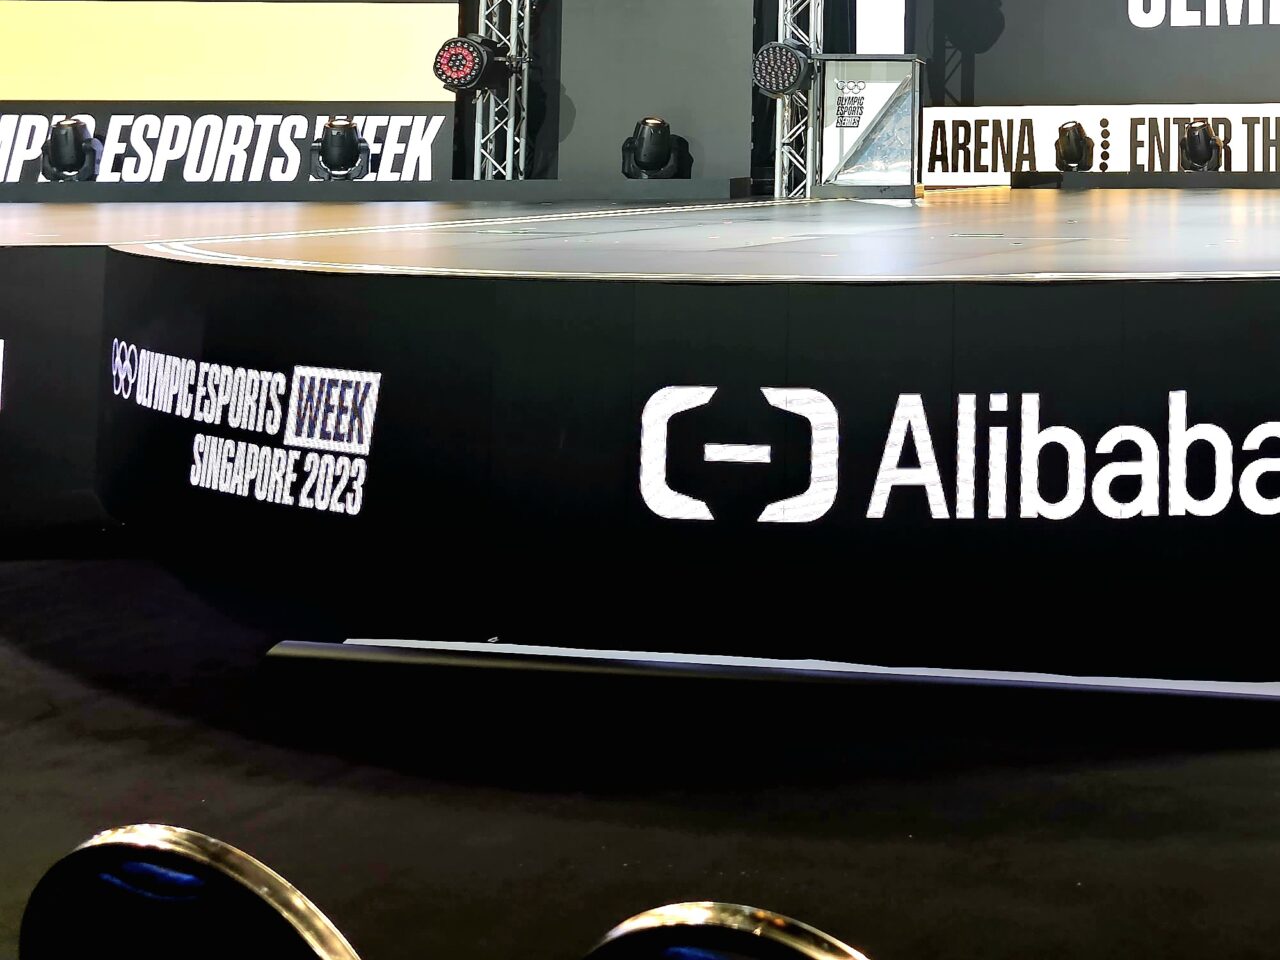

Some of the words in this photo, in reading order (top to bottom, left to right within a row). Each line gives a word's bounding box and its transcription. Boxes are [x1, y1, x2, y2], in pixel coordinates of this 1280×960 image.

[836, 105, 864, 116] ESPORTS
[837, 96, 864, 106] OLYMPIC
[96, 114, 308, 182] ESPORTS
[928, 118, 1037, 173] ARENA
[136, 348, 197, 419] OLYMPIC
[194, 362, 286, 436] ESPORTS
[295, 374, 372, 446] WEEK
[190, 433, 302, 506] SINGAPORE
[299, 452, 368, 516] 2023
